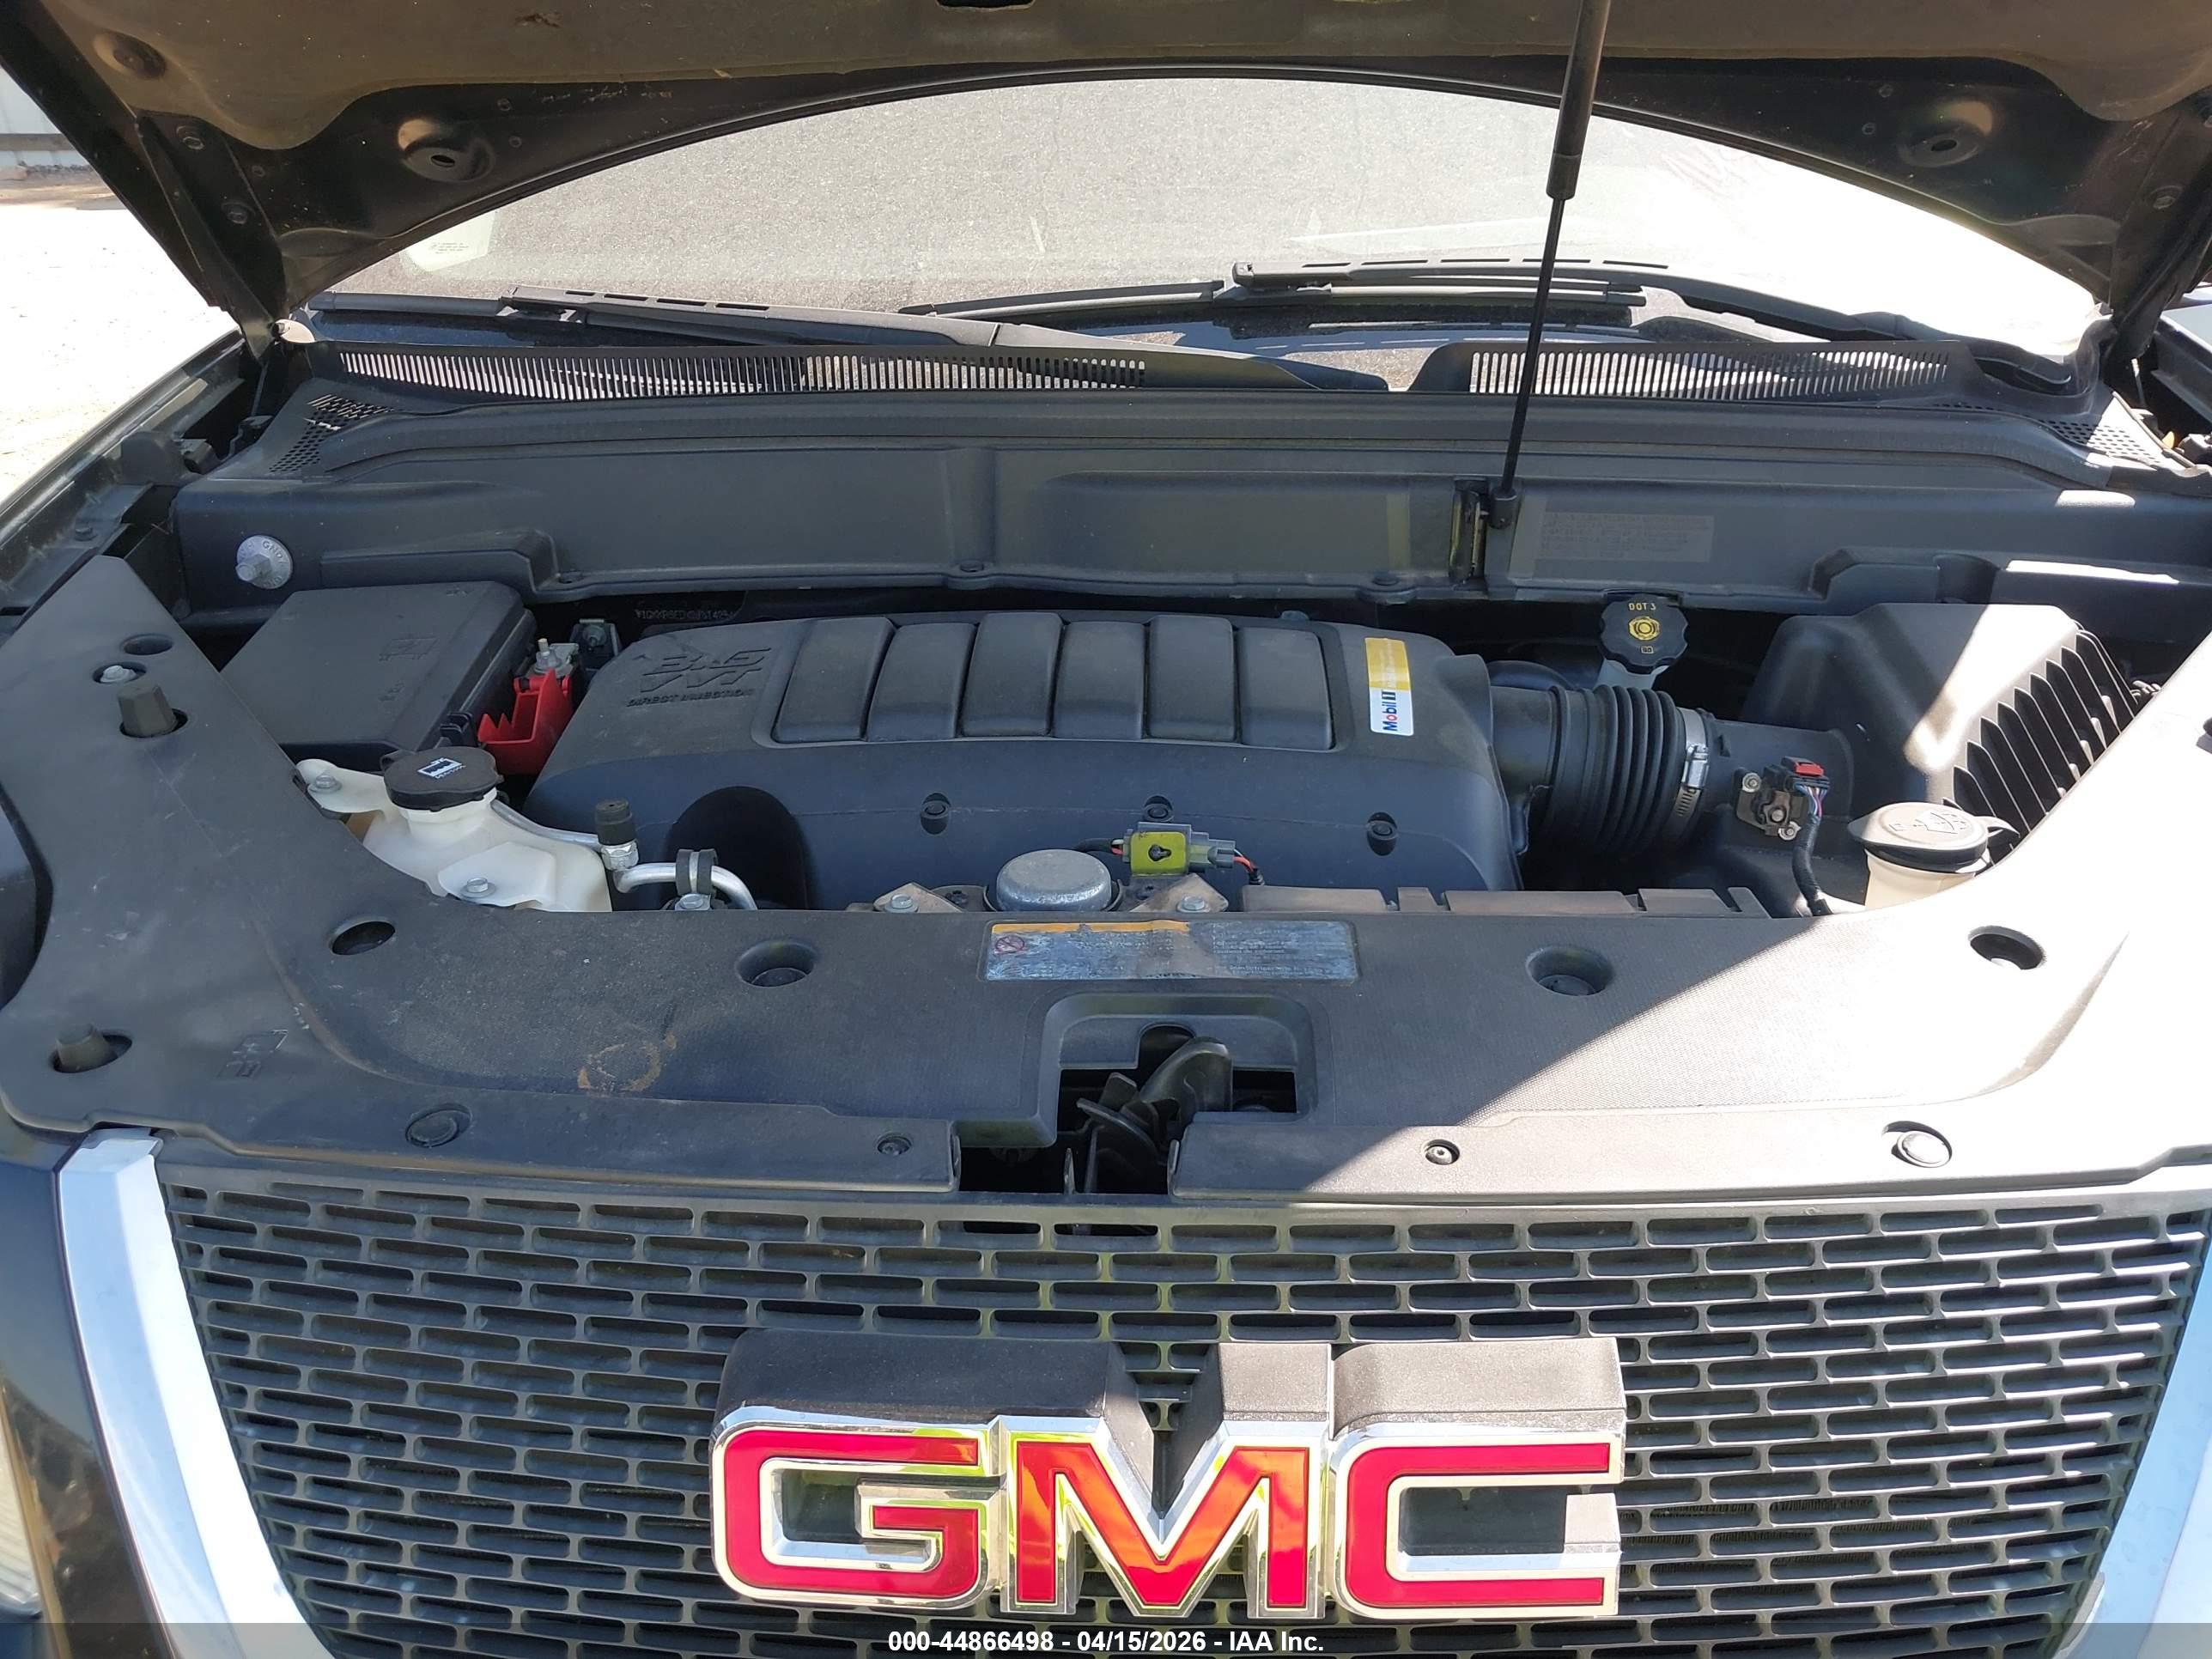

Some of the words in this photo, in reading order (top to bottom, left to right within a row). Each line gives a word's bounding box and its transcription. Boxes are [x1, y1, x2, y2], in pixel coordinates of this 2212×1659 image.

[1628, 602, 1649, 611] DOT
[1650, 602, 1657, 611] 3
[1382, 701, 1398, 732] Mobil
[709, 1410, 1626, 1620] GMC
